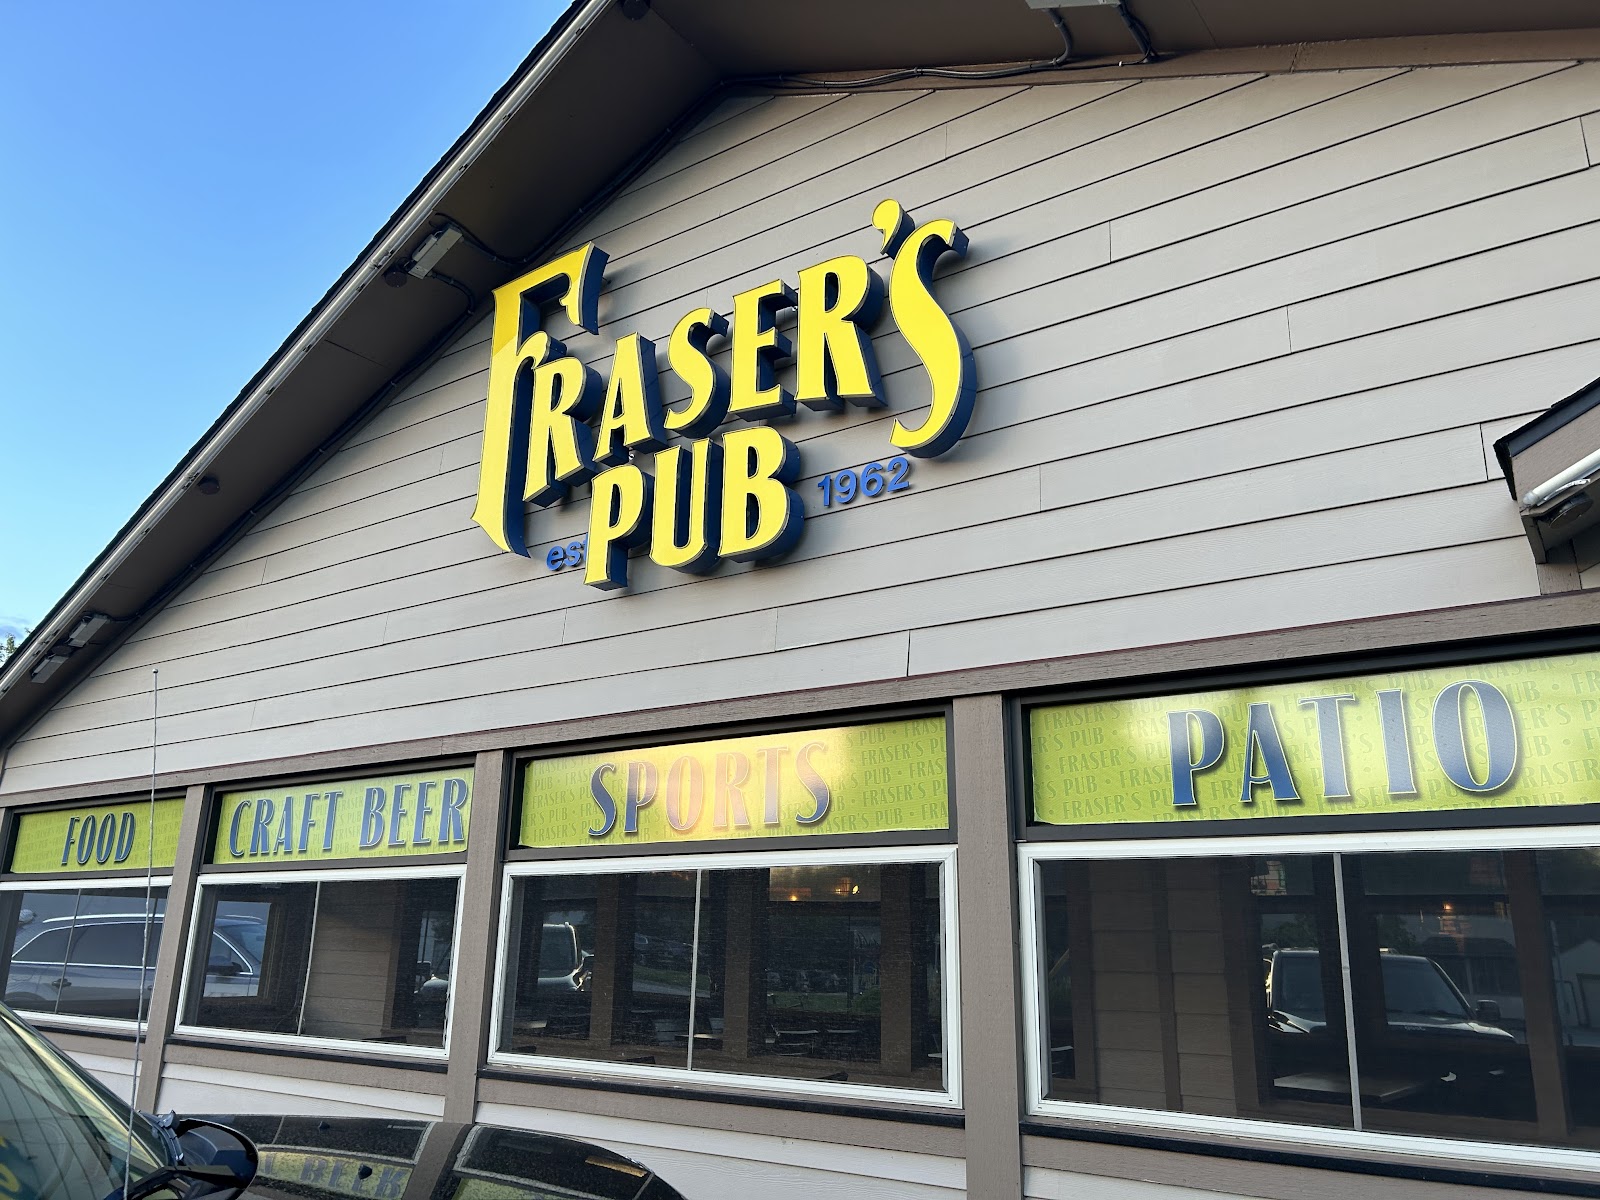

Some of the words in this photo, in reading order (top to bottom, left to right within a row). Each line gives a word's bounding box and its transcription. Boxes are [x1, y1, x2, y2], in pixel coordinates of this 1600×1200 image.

[470, 199, 974, 558] FRASER'S
[818, 457, 911, 507] 1962
[583, 427, 801, 589] PUB
[1069, 726, 1105, 749] PUB
[1166, 680, 1518, 806] PATIO
[861, 739, 925, 767] FRASER'S
[1058, 745, 1138, 776] FRASER'S
[588, 741, 829, 837] SPORTS
[863, 766, 892, 787] PUB
[1063, 774, 1098, 797] PUB
[532, 788, 576, 810] FRASER'S
[862, 781, 927, 808] FRASER'S
[1062, 791, 1143, 820] FRASER'S
[229, 790, 343, 857] CRAFT
[359, 777, 469, 849] BEER
[550, 807, 568, 823] PUB
[875, 807, 903, 827] PUB
[61, 812, 136, 866] FOOD
[533, 822, 578, 843] FRASER'S
